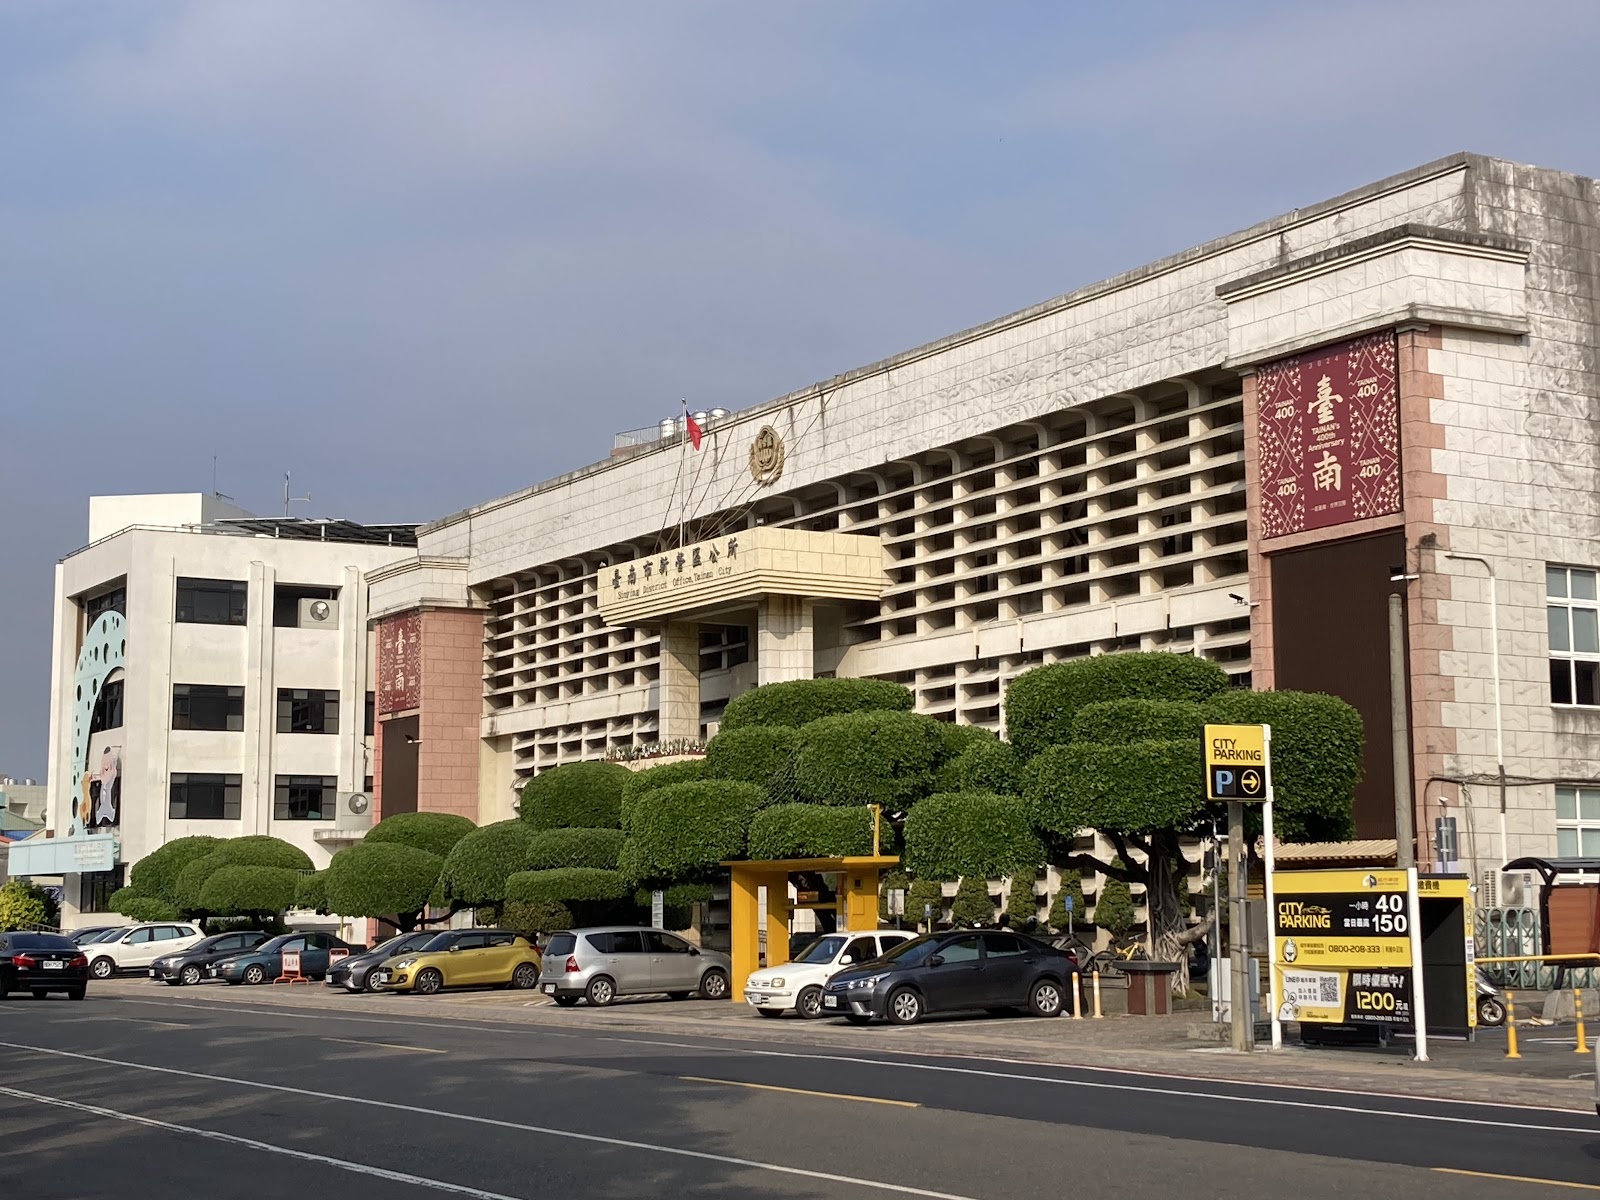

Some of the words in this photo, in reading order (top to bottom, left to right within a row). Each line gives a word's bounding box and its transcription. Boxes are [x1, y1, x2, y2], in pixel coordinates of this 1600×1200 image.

[1308, 355, 1339, 369] 2024
[1357, 376, 1378, 387] TAINAN
[1357, 383, 1378, 398] 400
[1274, 399, 1294, 409] TAINAN
[1274, 405, 1295, 420] 400
[1308, 438, 1345, 452] Anniversary
[1359, 456, 1380, 467] TAINAN
[1312, 450, 1342, 492] 南
[1359, 464, 1381, 478] 400
[1276, 475, 1297, 486] TAINAN
[1276, 482, 1297, 497] 400
[643, 581, 667, 594] District
[718, 566, 732, 576] City
[1213, 738, 1237, 749] CITY
[1213, 749, 1261, 761] PARKING
[1215, 770, 1234, 795] P
[1278, 902, 1304, 915] CITY
[1349, 901, 1369, 911] 一小時
[1375, 894, 1403, 913] 40
[1279, 914, 1331, 928] PARKING
[1343, 918, 1370, 928] 當日最高
[1371, 914, 1408, 933] 150
[1328, 944, 1381, 953] 0800-208-333
[1355, 990, 1395, 1011] 1200
